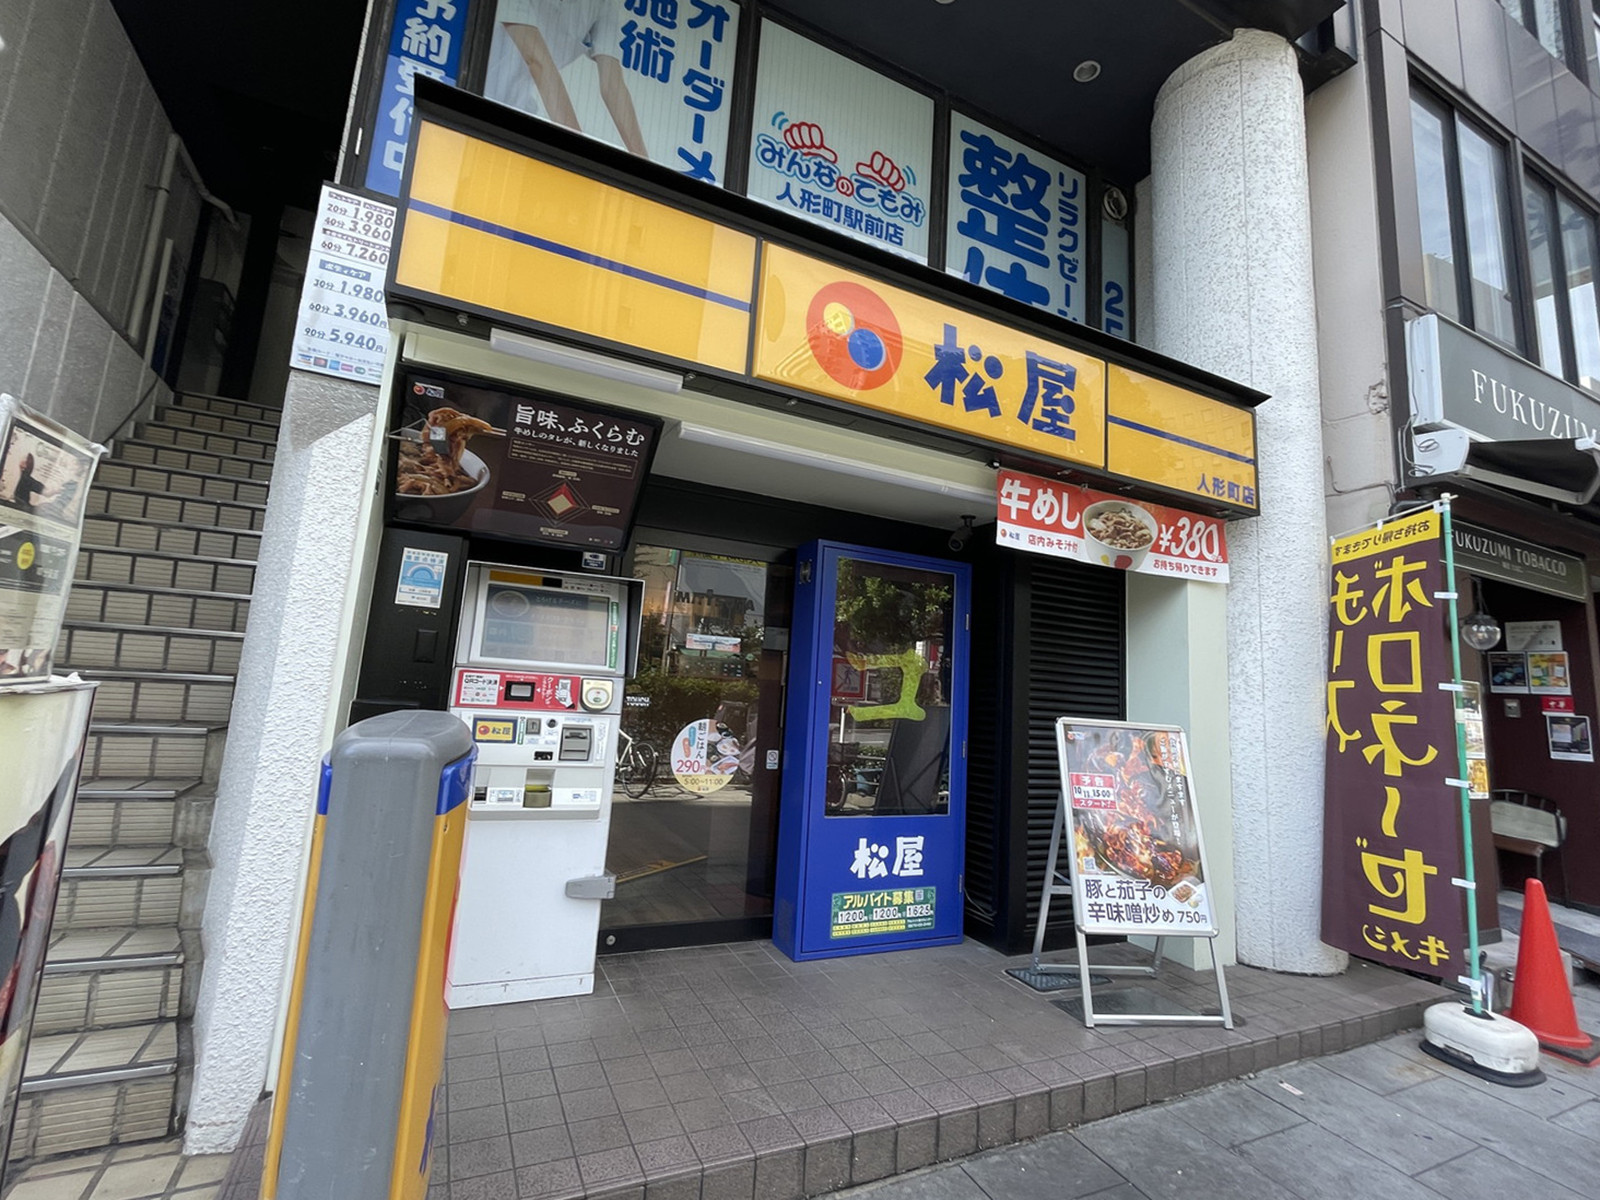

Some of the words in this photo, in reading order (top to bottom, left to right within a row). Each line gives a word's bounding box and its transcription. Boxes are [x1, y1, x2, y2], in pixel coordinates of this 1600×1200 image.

[756, 134, 925, 227] みんなのてもみ
[324, 216, 345, 229] 40分
[327, 203, 347, 216] 20分
[776, 182, 906, 247] 人形町駅前店
[321, 240, 342, 253] 60分
[313, 278, 334, 291] 30分
[309, 301, 330, 314] 60分
[304, 327, 325, 340] 90分
[924, 323, 1078, 441] 松屋
[515, 404, 645, 446] 旨味、ふくらむ
[513, 427, 639, 457] 牛めしのタレが、新しくなりました
[1198, 473, 1256, 506] 人形町店
[1000, 478, 1080, 530] 牛めし
[1159, 516, 1220, 561] ¥380
[1153, 559, 1218, 577] お持ち帰りできます
[1514, 547, 1567, 577] TOBACCO
[850, 836, 924, 879] 松屋
[843, 890, 915, 909] アルバイト募集
[1085, 879, 1166, 901] 豚と茄子の
[1088, 902, 1175, 924] 辛味噌炒め
